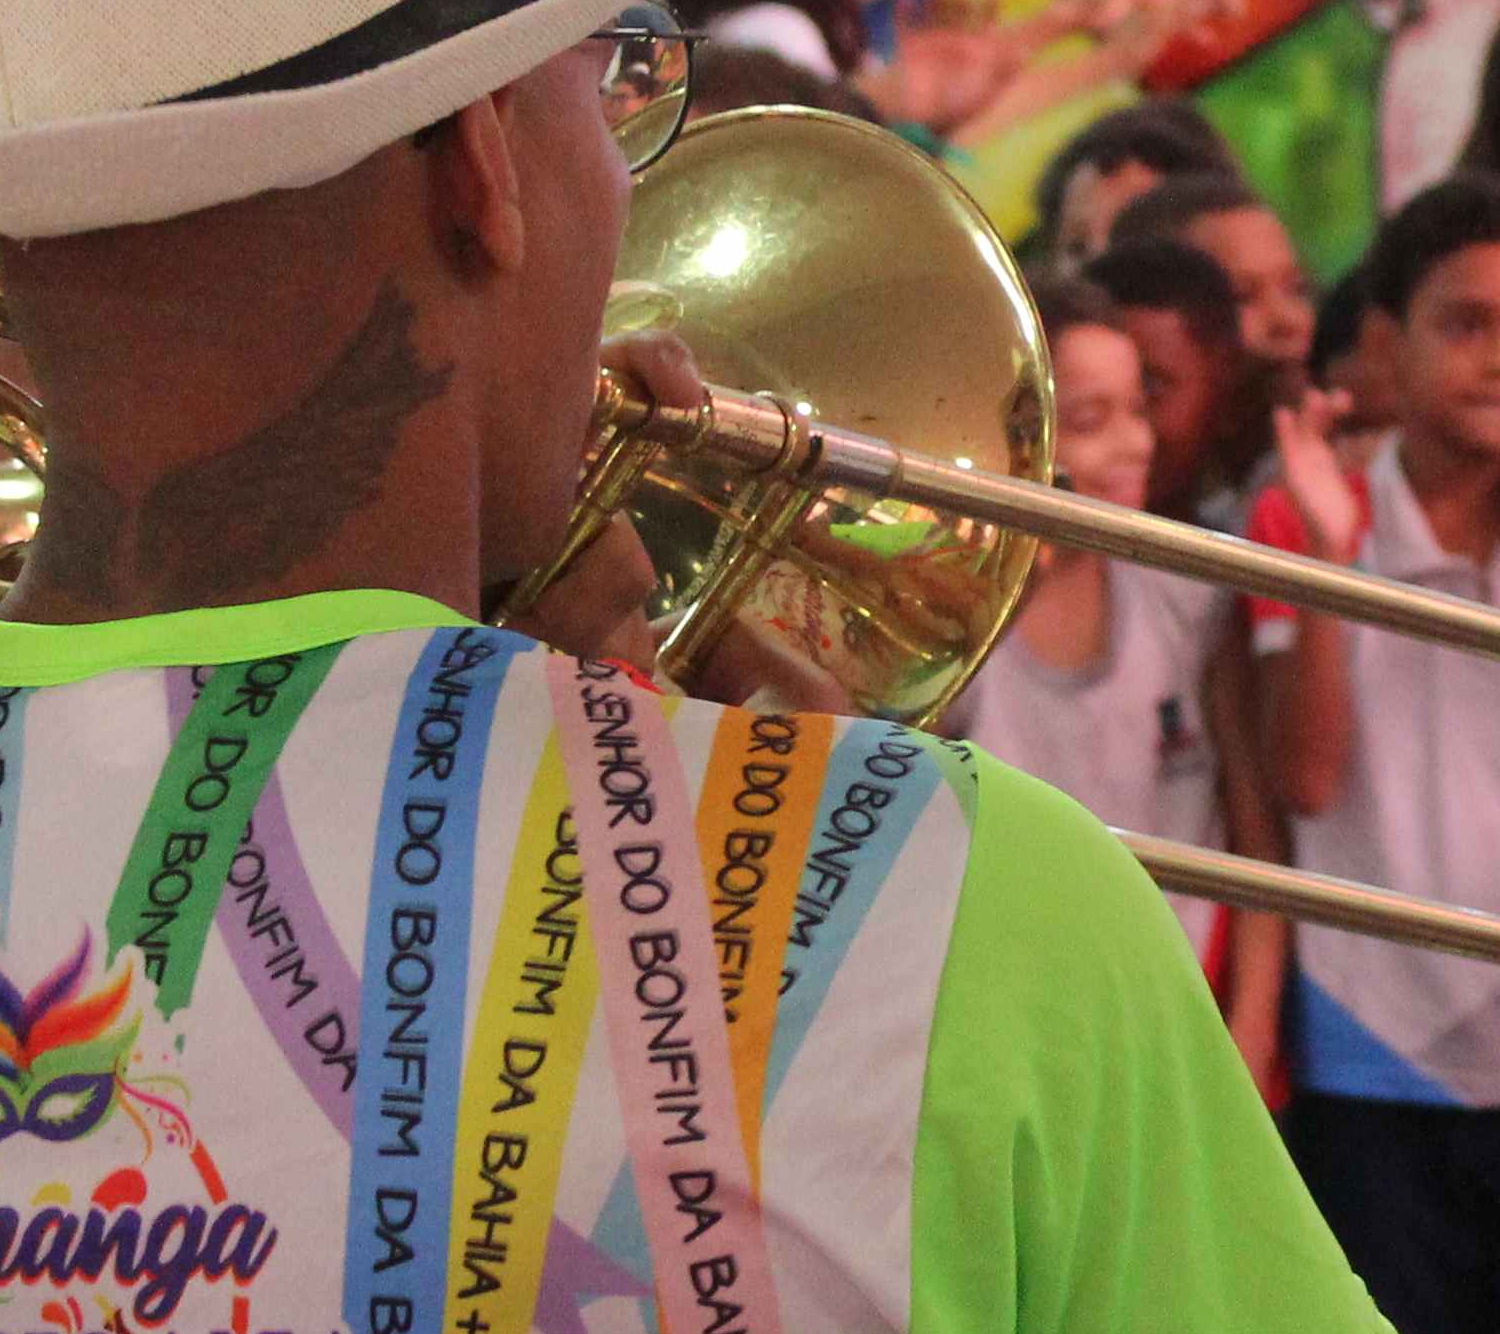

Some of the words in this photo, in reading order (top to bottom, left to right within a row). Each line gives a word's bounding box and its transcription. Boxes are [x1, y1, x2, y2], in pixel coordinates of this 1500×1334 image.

[184, 733, 252, 814] DO
[580, 684, 654, 830] SENHOR
[732, 762, 787, 818] DO
[863, 739, 926, 780] DO
[394, 801, 447, 887] DO
[612, 843, 670, 917] DO
[787, 780, 893, 949] BONFIM
[376, 905, 438, 1158] BONFIM
[628, 928, 707, 1147] BONFIM
[490, 1039, 548, 1116] DA
[373, 1185, 419, 1275] DA
[456, 1132, 530, 1302] BAHIA
[667, 1167, 724, 1244] DA
